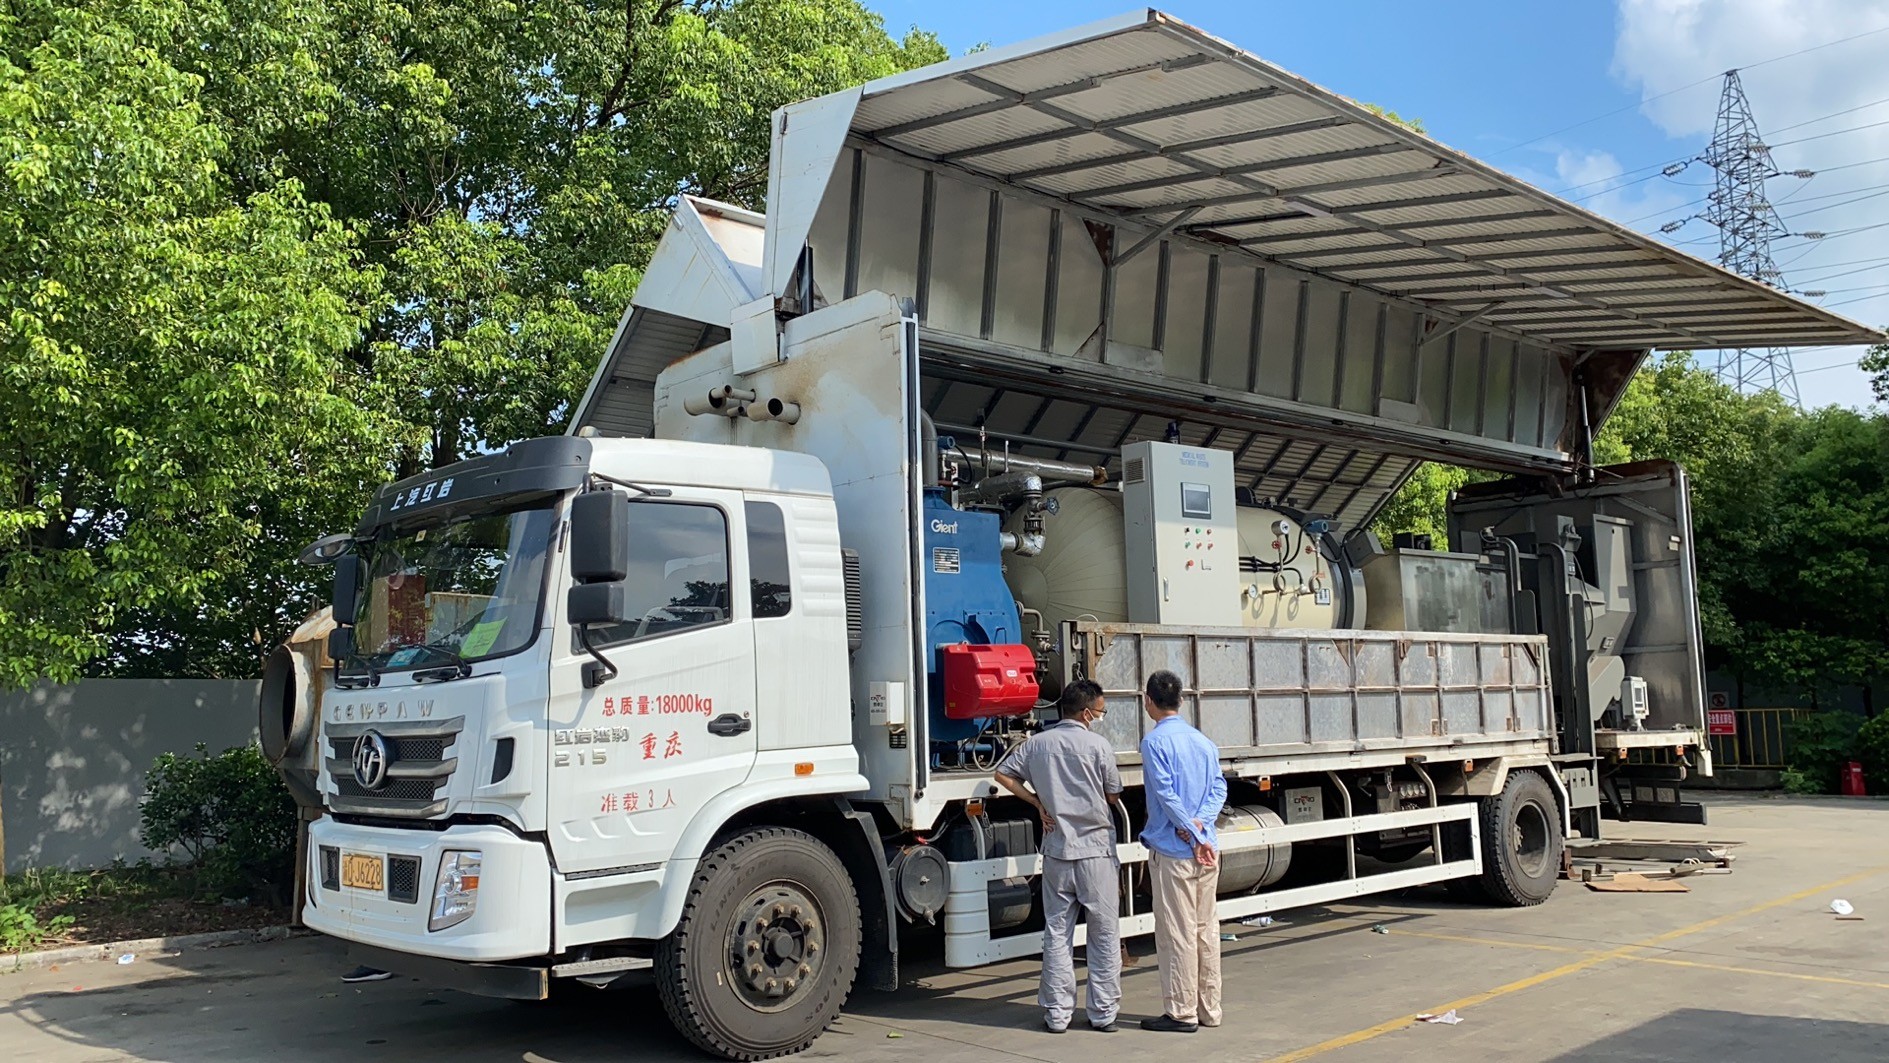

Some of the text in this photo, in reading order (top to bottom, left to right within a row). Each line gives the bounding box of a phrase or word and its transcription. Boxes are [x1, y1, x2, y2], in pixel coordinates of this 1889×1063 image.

[390, 478, 454, 511] 上汽红岩
[602, 694, 713, 717] 总质量:18000kg
[554, 748, 607, 768] 215
[639, 730, 683, 760] 重庆
